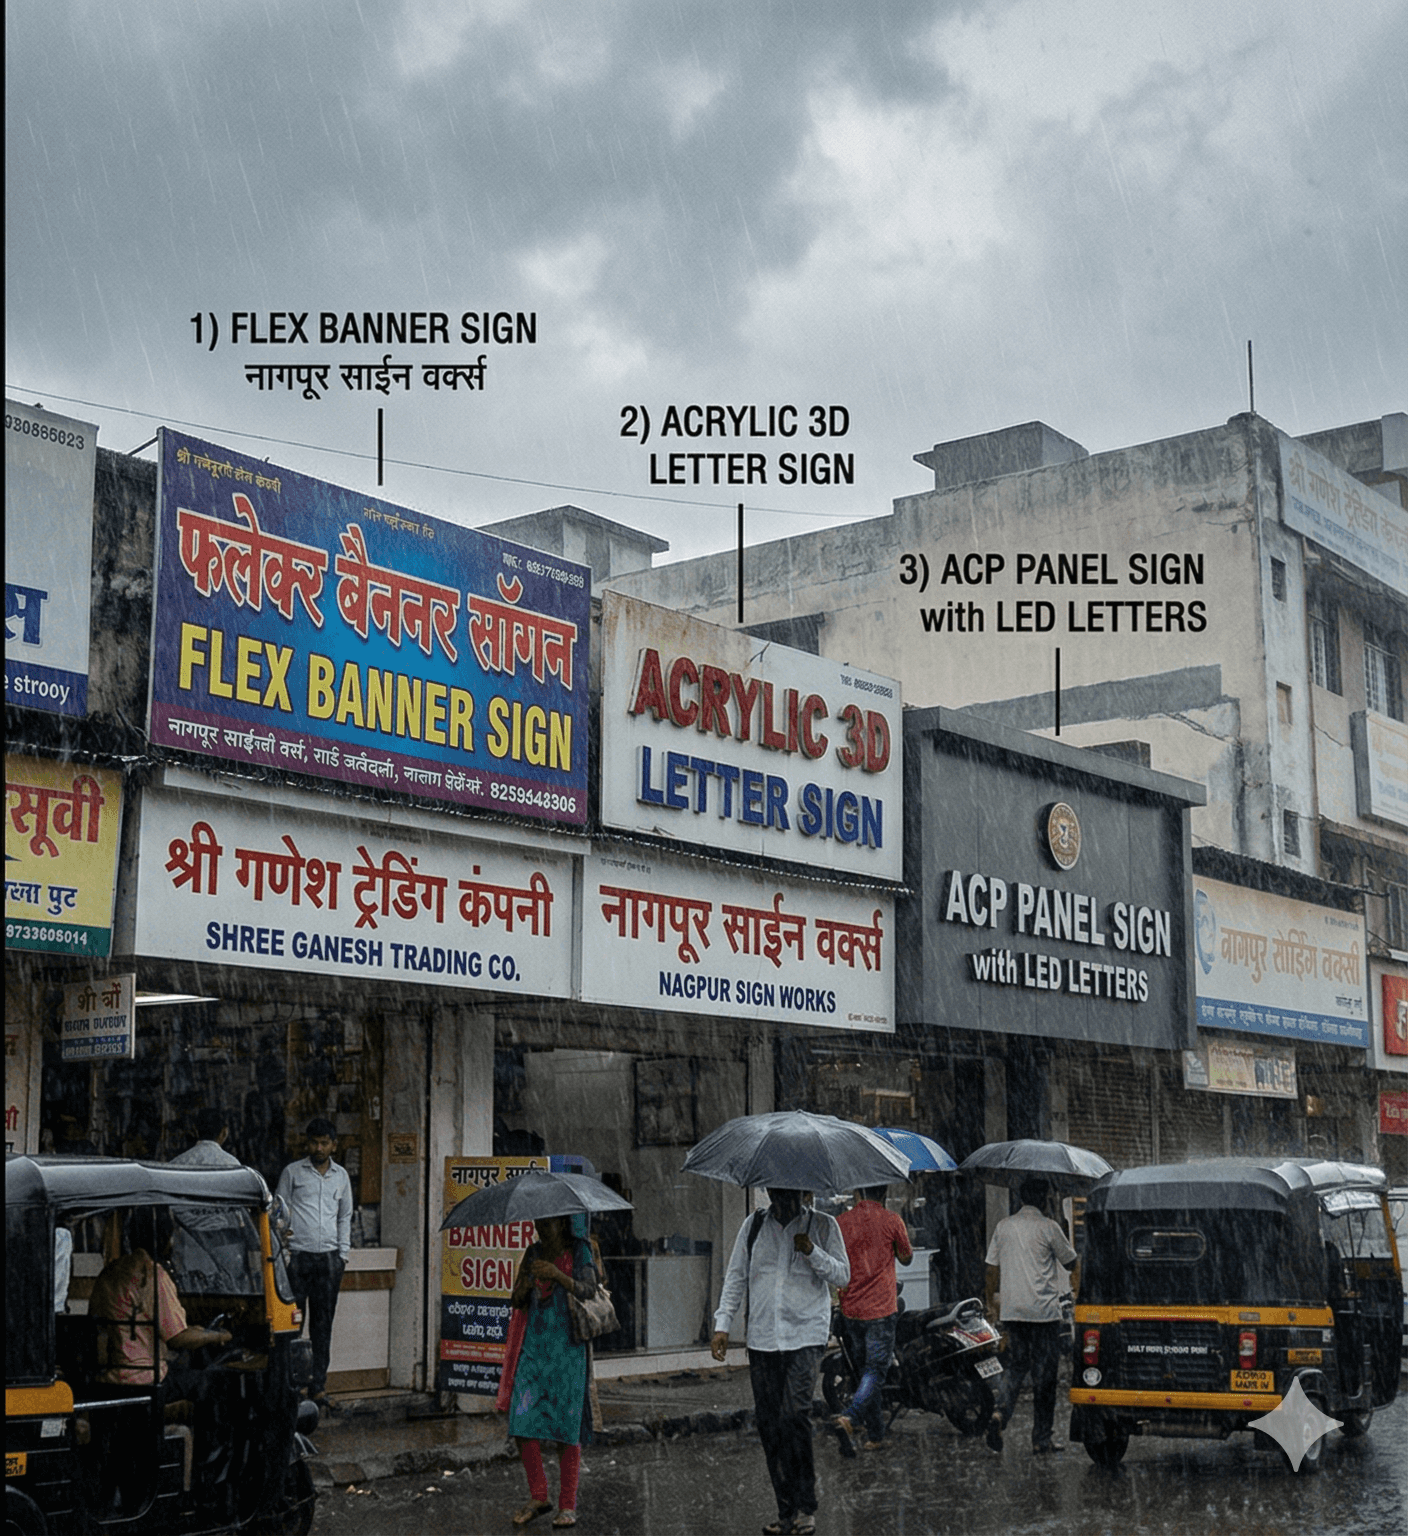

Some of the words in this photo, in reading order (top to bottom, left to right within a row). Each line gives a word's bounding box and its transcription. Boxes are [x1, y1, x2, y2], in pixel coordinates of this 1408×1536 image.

[14, 674, 70, 705] strooy
[179, 622, 294, 712] FLEX
[308, 654, 473, 752] BANNER
[487, 696, 572, 772] SIGN
[628, 647, 829, 760] ACRYLIC
[837, 703, 891, 773] 3D
[168, 718, 219, 750] नागपूर
[637, 745, 790, 830] LETTER
[798, 783, 883, 848] SIGN
[165, 821, 222, 896] श्री
[235, 834, 341, 911] गणेश
[352, 846, 447, 930] ट्रेडिंग
[458, 865, 553, 937] कंपनी
[599, 885, 712, 964] नागपूर
[722, 893, 806, 968] साईन
[815, 909, 883, 971] वर्क्स
[946, 870, 1007, 928] ACP
[1017, 882, 1105, 947] PANEL
[1113, 902, 1171, 957] SIGN
[206, 921, 284, 956] SHREE
[292, 931, 383, 967] GANESH
[390, 943, 482, 978] TRADING
[488, 954, 521, 982] CO.
[972, 948, 1018, 985] with
[1024, 954, 1062, 990] LED
[1068, 961, 1149, 1002] LETTERS
[659, 971, 731, 1003] NAGPUR
[735, 979, 775, 1008] SIGN
[779, 985, 836, 1014] WORKS
[449, 1221, 535, 1249] BANNER
[462, 1258, 512, 1290] SIGN
